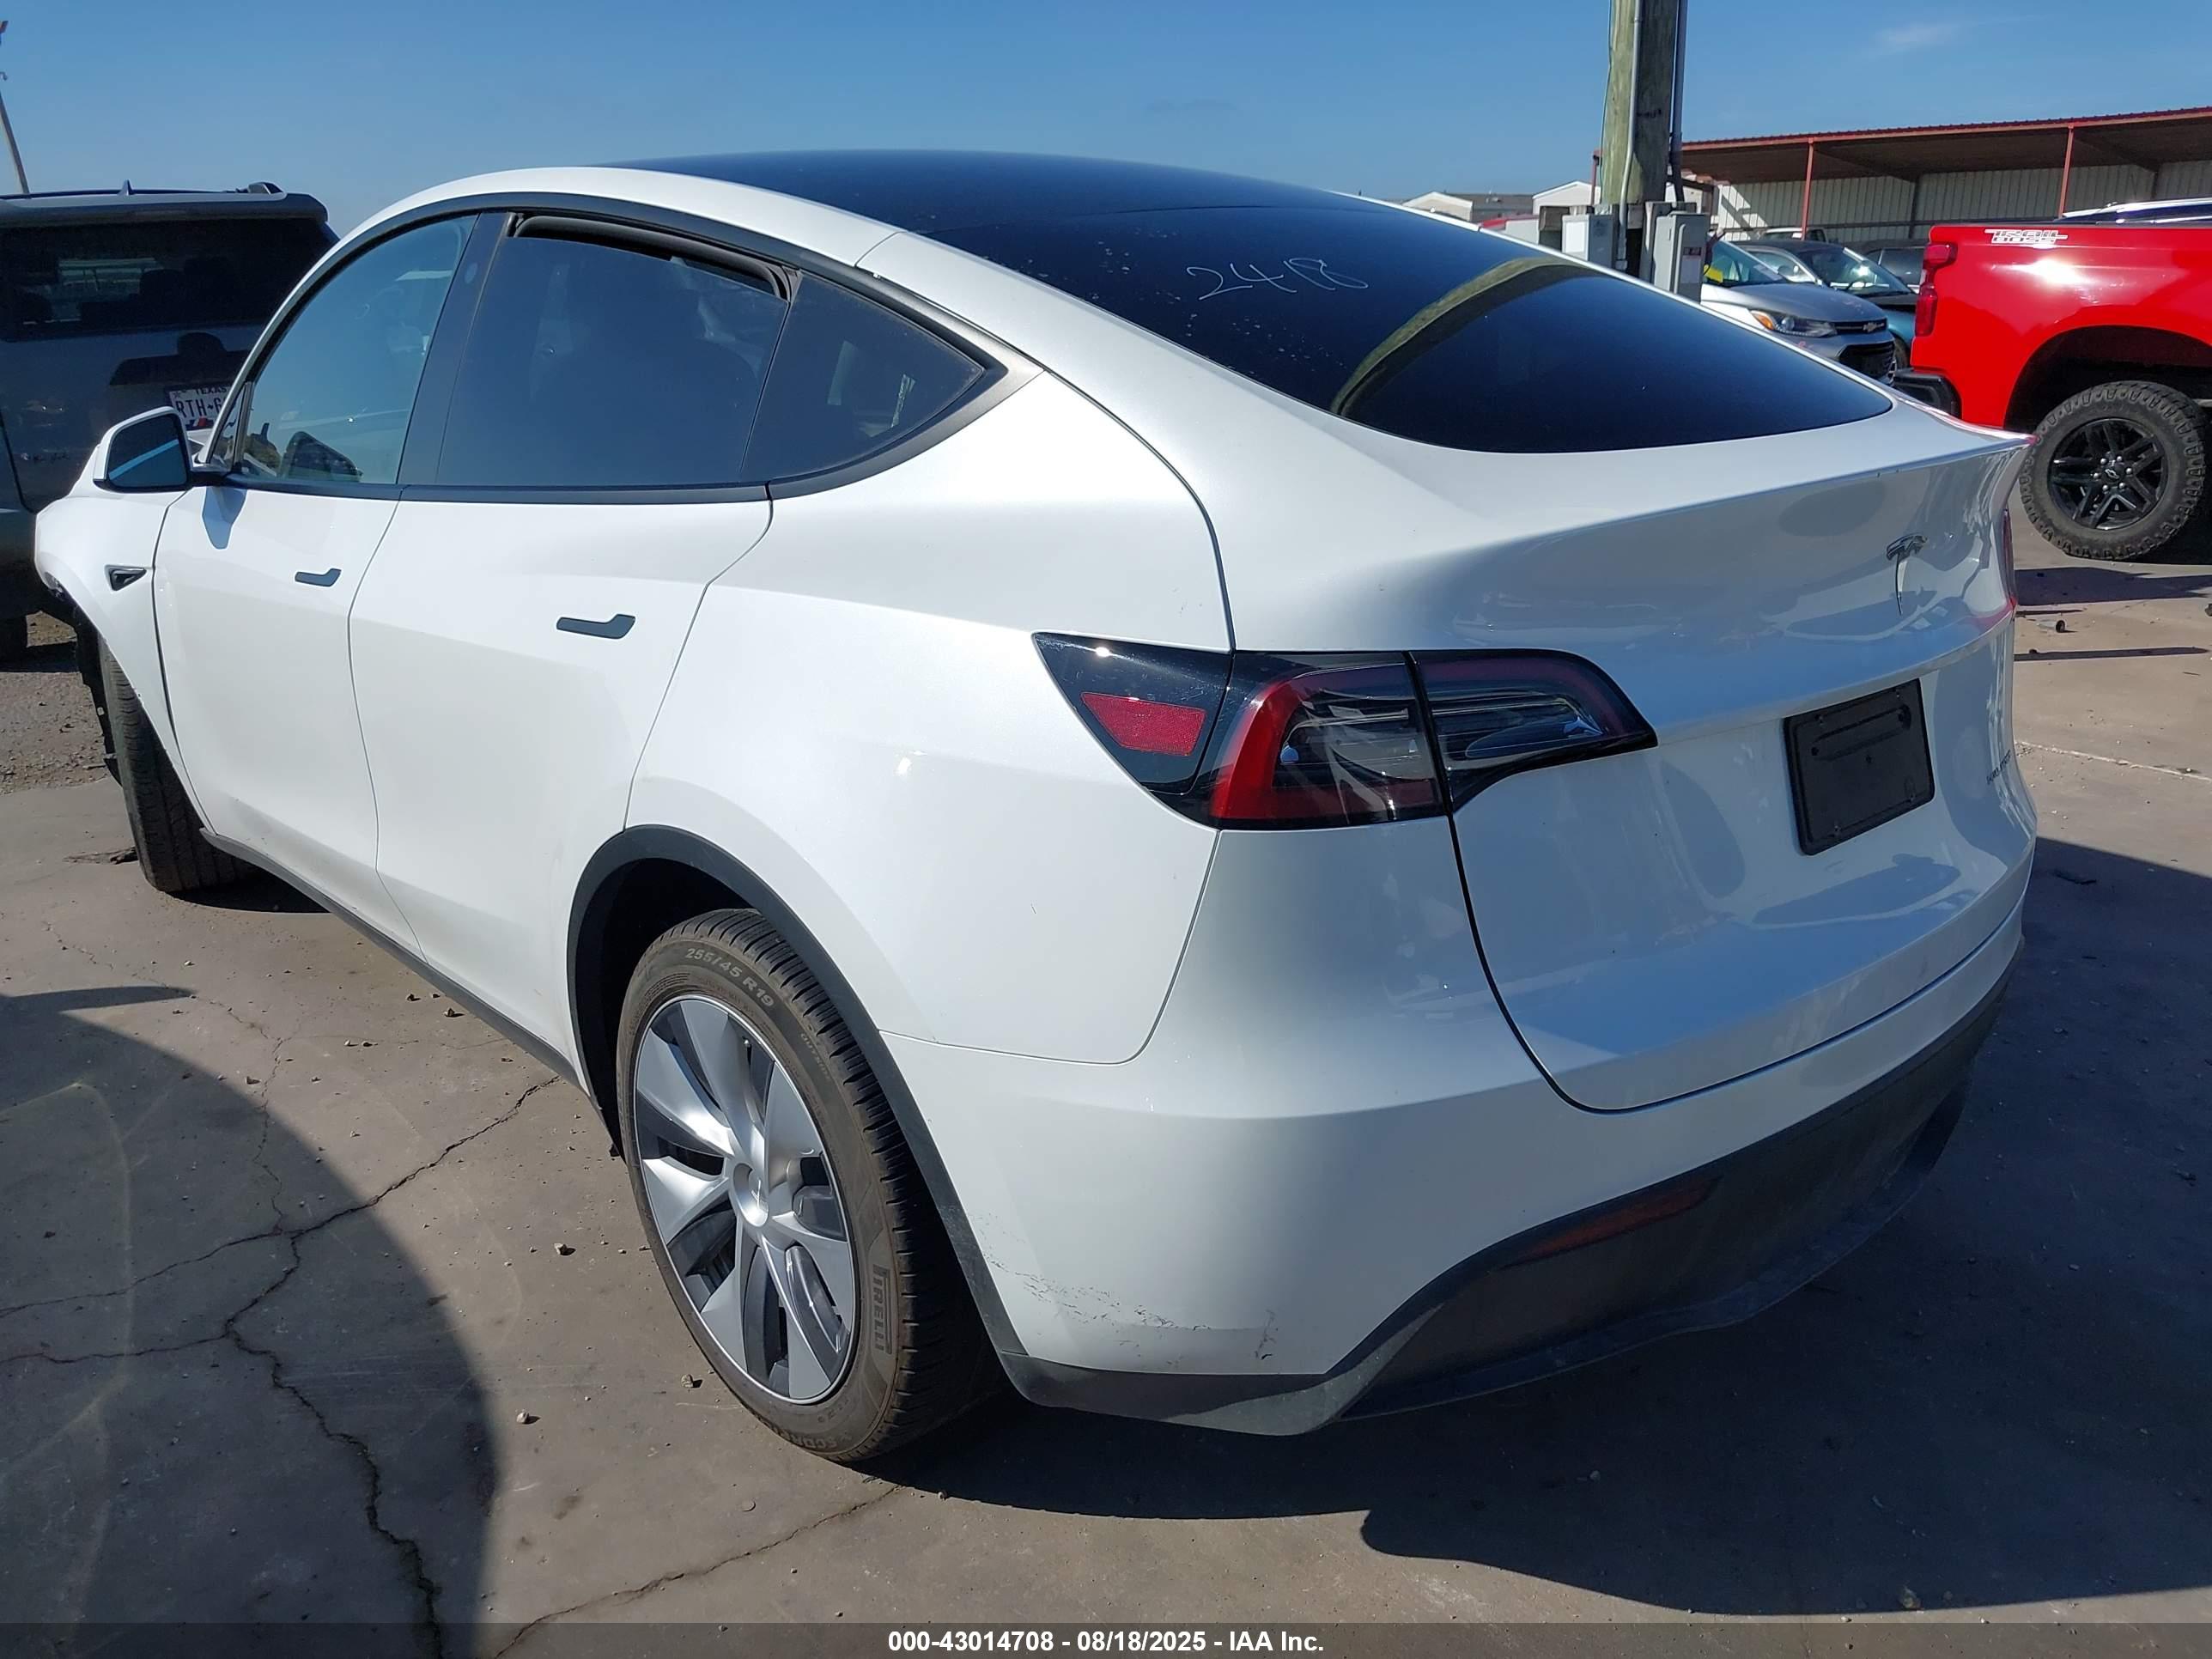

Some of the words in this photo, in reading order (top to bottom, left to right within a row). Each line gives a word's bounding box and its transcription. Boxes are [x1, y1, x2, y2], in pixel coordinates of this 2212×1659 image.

[175, 396, 227, 418] RTH-6
[196, 386, 228, 395] TEXAS
[684, 947, 743, 978] 255/45
[742, 976, 775, 1007] R19
[872, 1263, 892, 1355] PIRELLI
